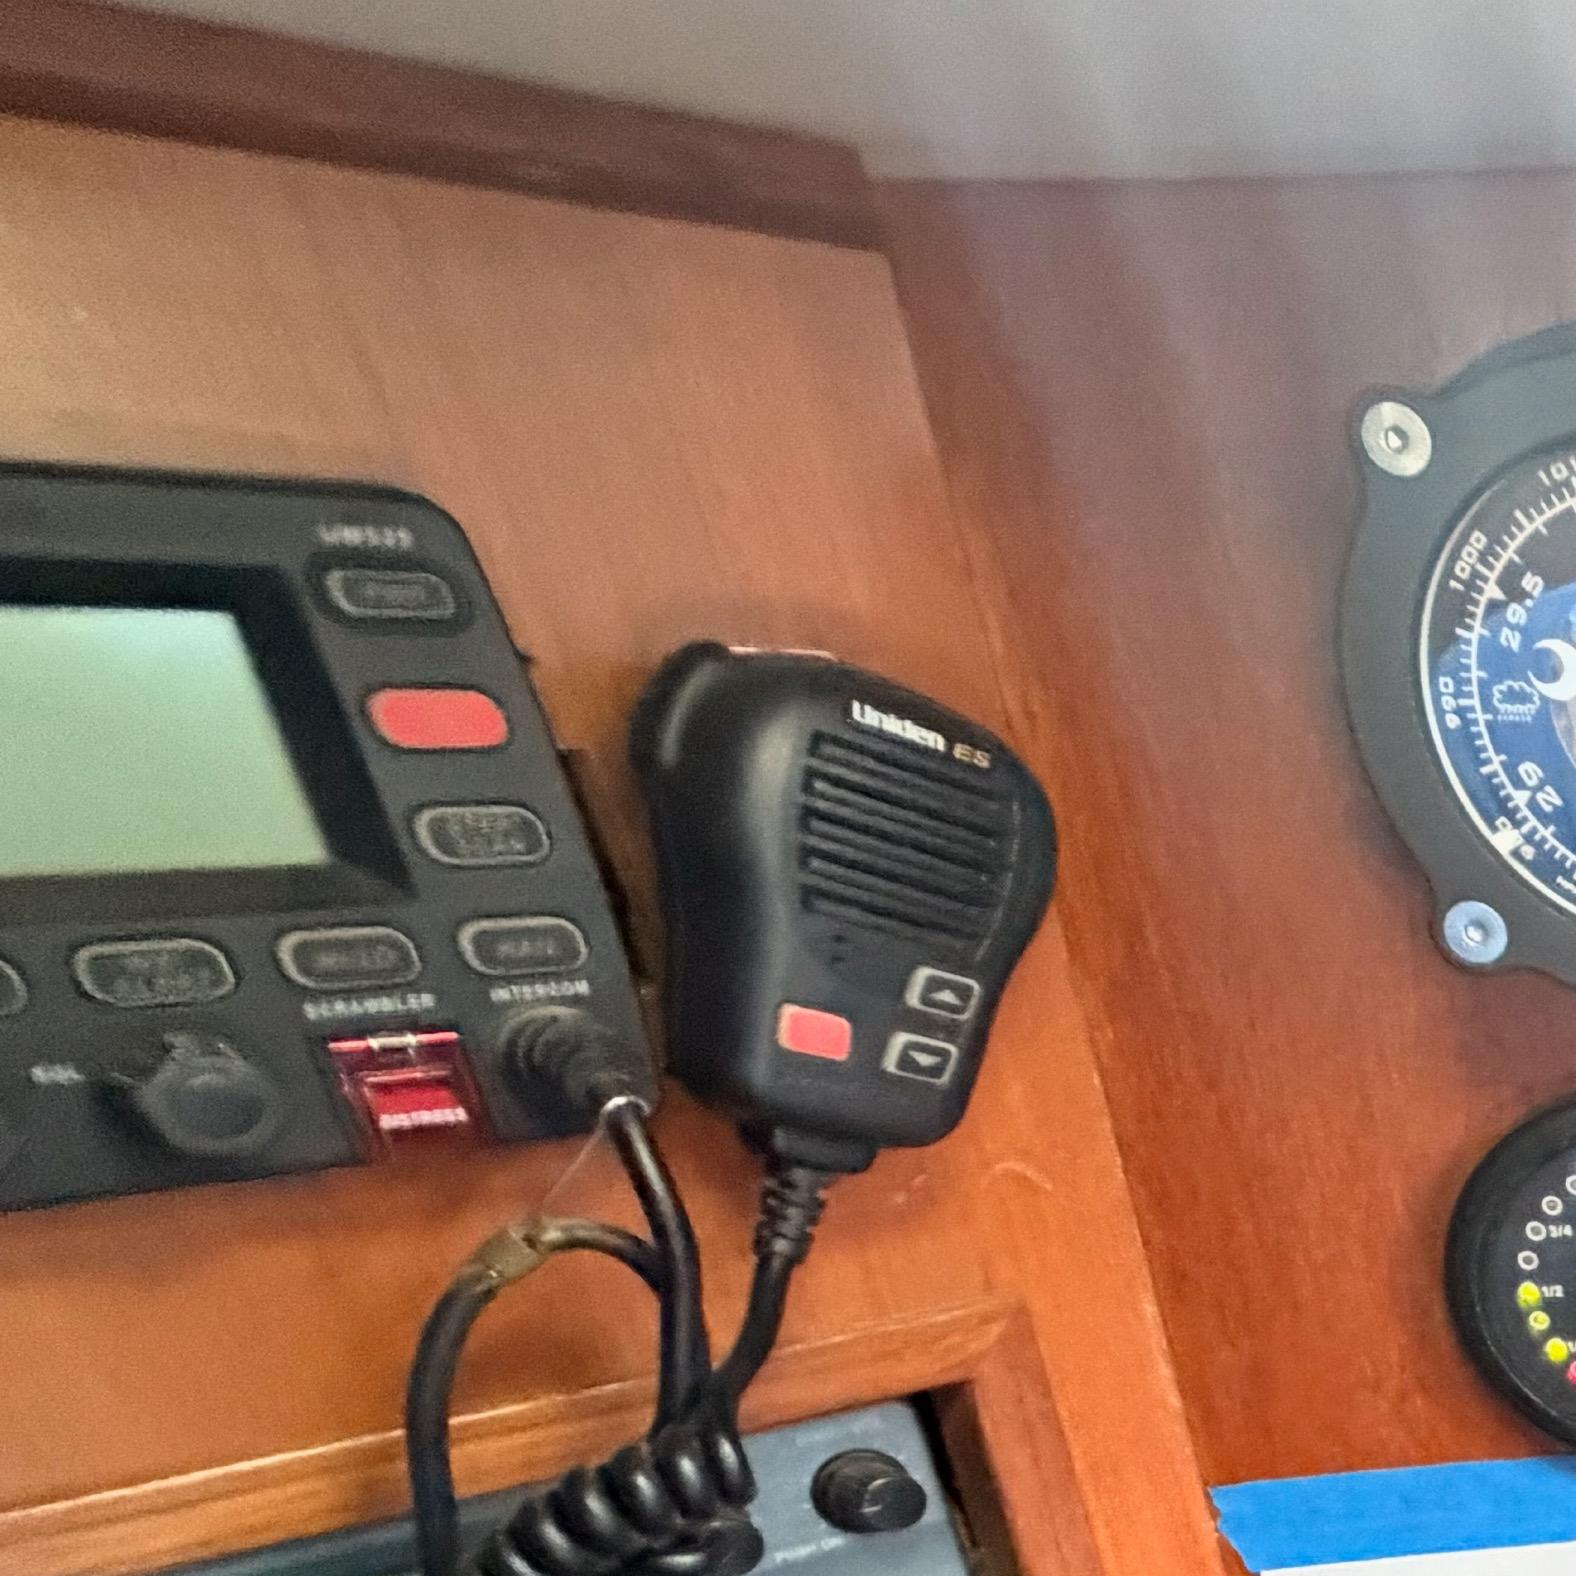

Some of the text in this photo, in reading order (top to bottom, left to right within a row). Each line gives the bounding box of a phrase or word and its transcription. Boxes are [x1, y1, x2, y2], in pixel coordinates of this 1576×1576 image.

[1449, 529, 1489, 592] 1000
[1499, 570, 1546, 652] 29.5
[851, 699, 947, 752] Uniden
